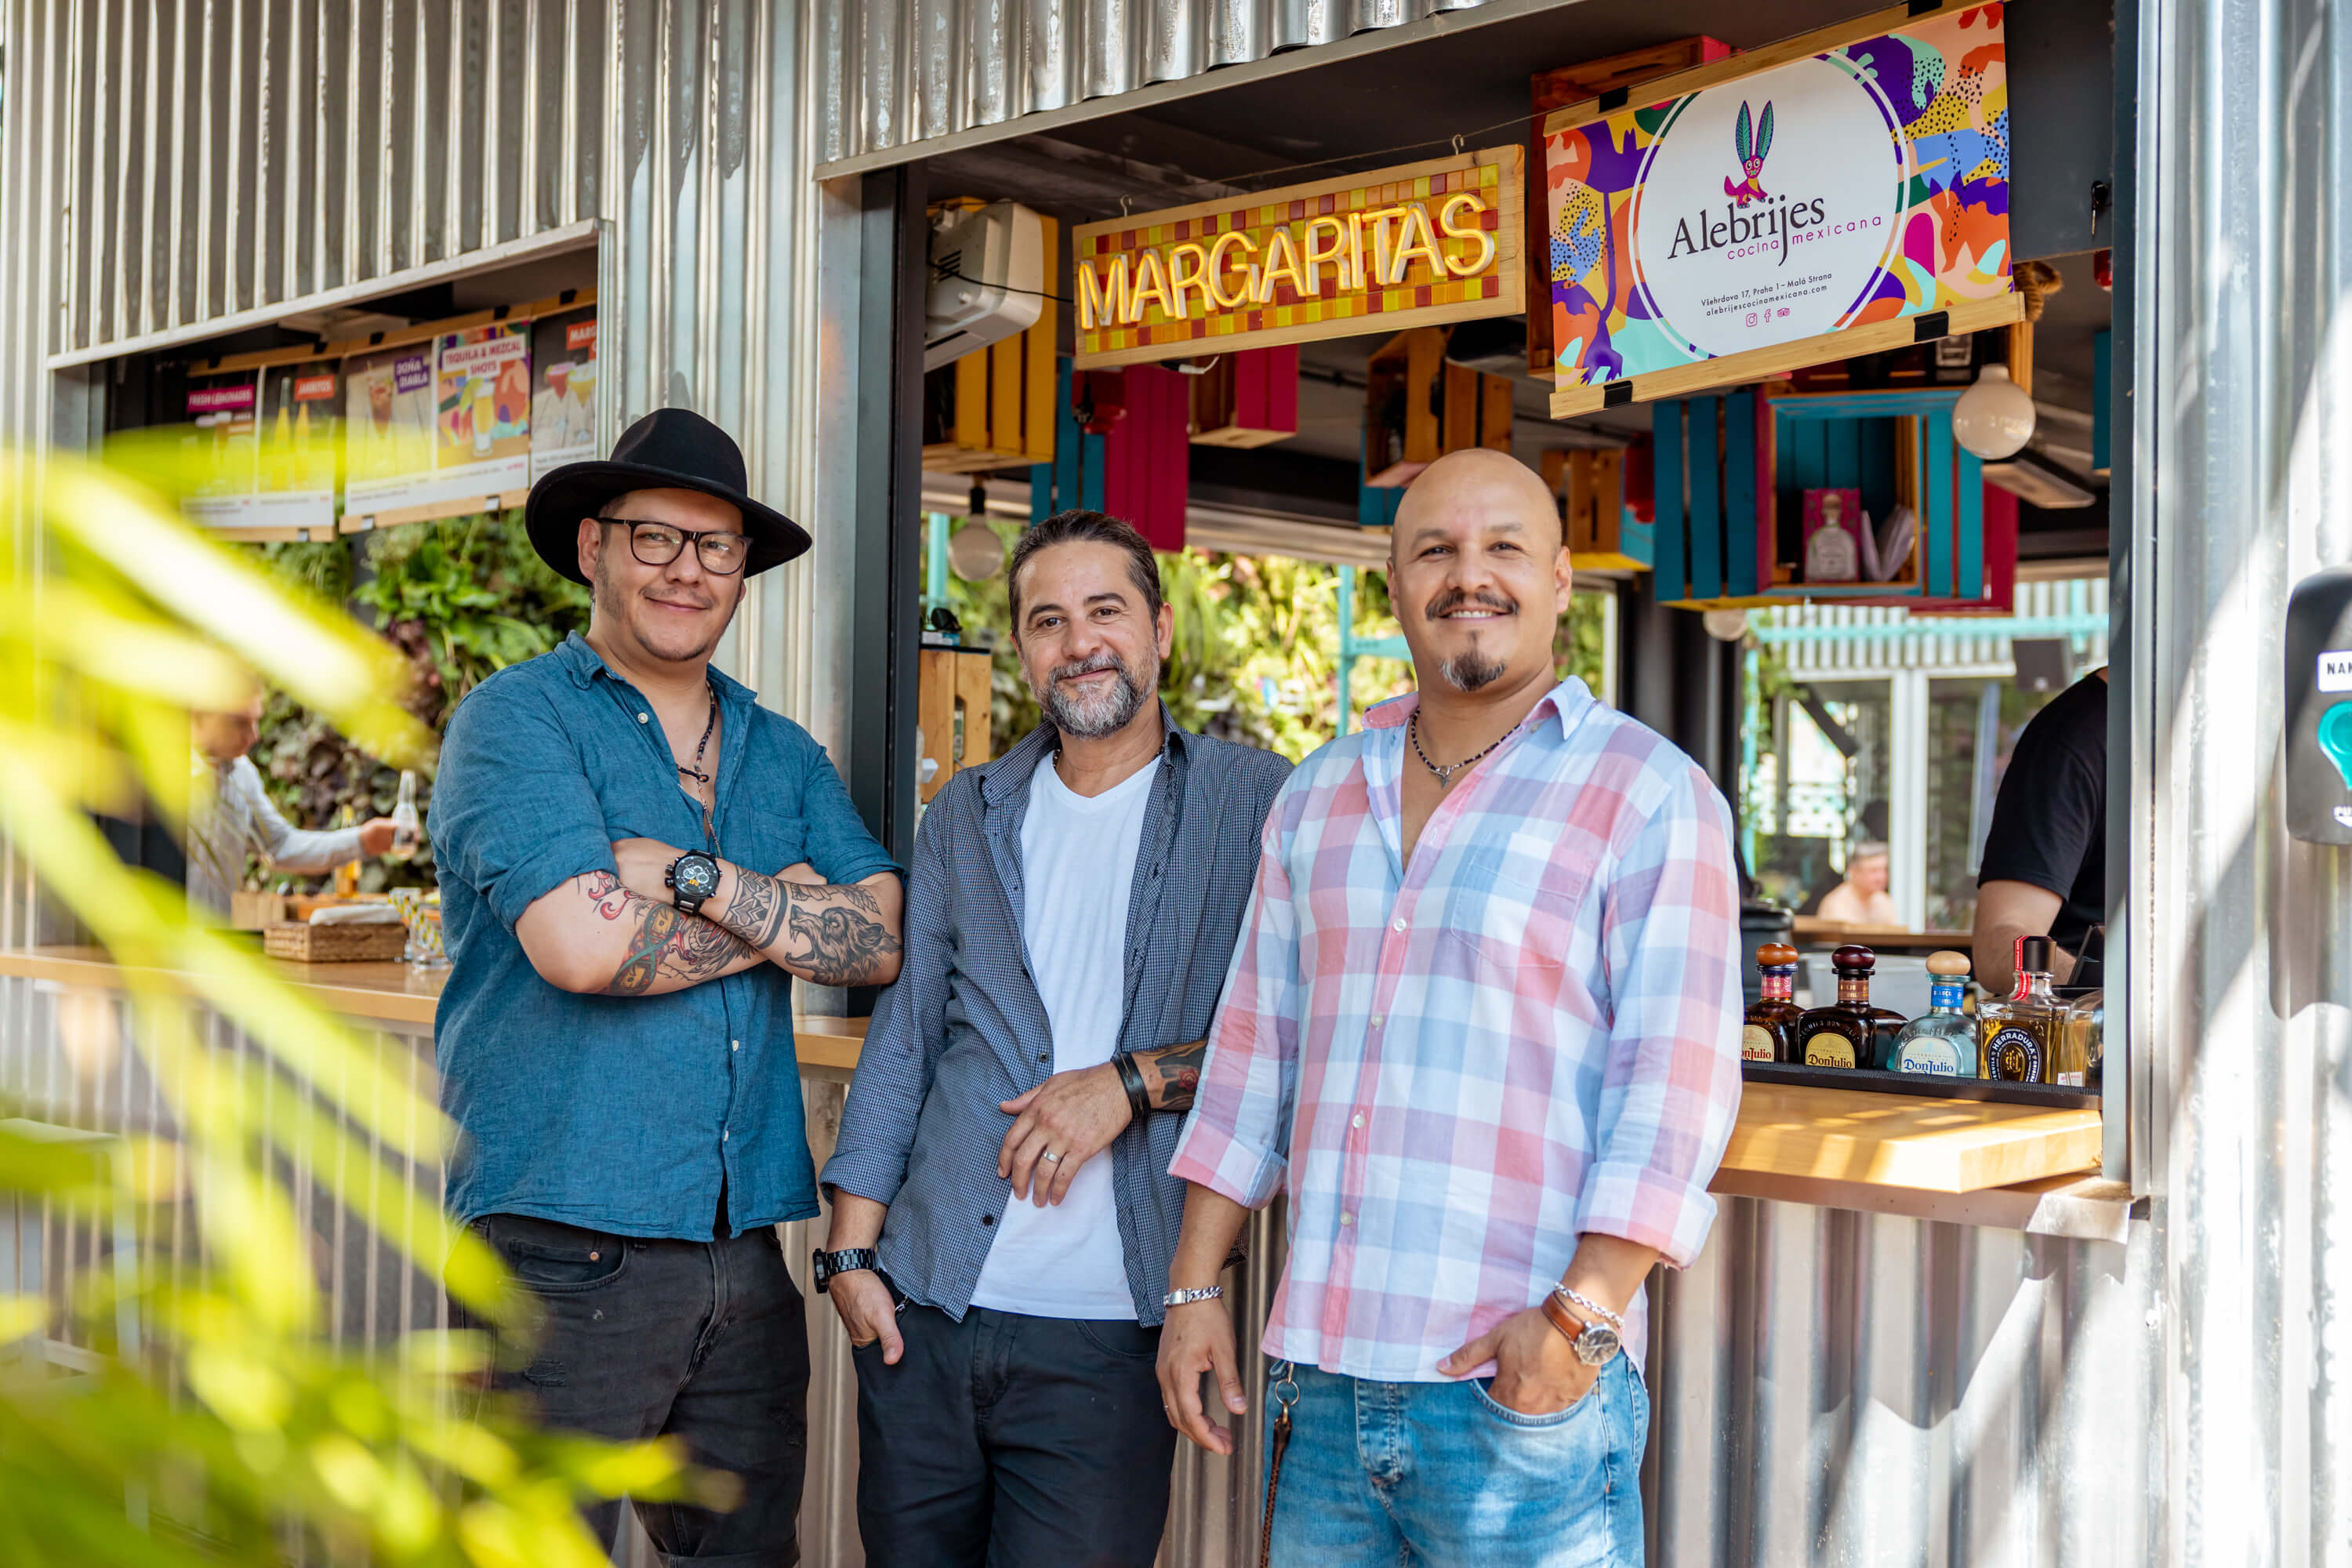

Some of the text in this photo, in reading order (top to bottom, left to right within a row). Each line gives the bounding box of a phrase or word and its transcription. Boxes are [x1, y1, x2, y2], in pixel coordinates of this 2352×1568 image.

[1668, 194, 1825, 267] Alebrijes
[1727, 216, 1882, 260] cocina mexicana
[1079, 193, 1495, 329] MARGARITAS
[1741, 289, 1751, 299] 17,
[1753, 285, 1773, 296] Praha
[1808, 272, 1832, 283] Strana
[1706, 285, 1828, 317] alebrijescocinamexicana.com
[445, 349, 478, 366] TEQUILA
[488, 338, 521, 358] MEZCAL
[469, 361, 498, 376] SHOTS
[1992, 1032, 2036, 1055] HERRADURA
